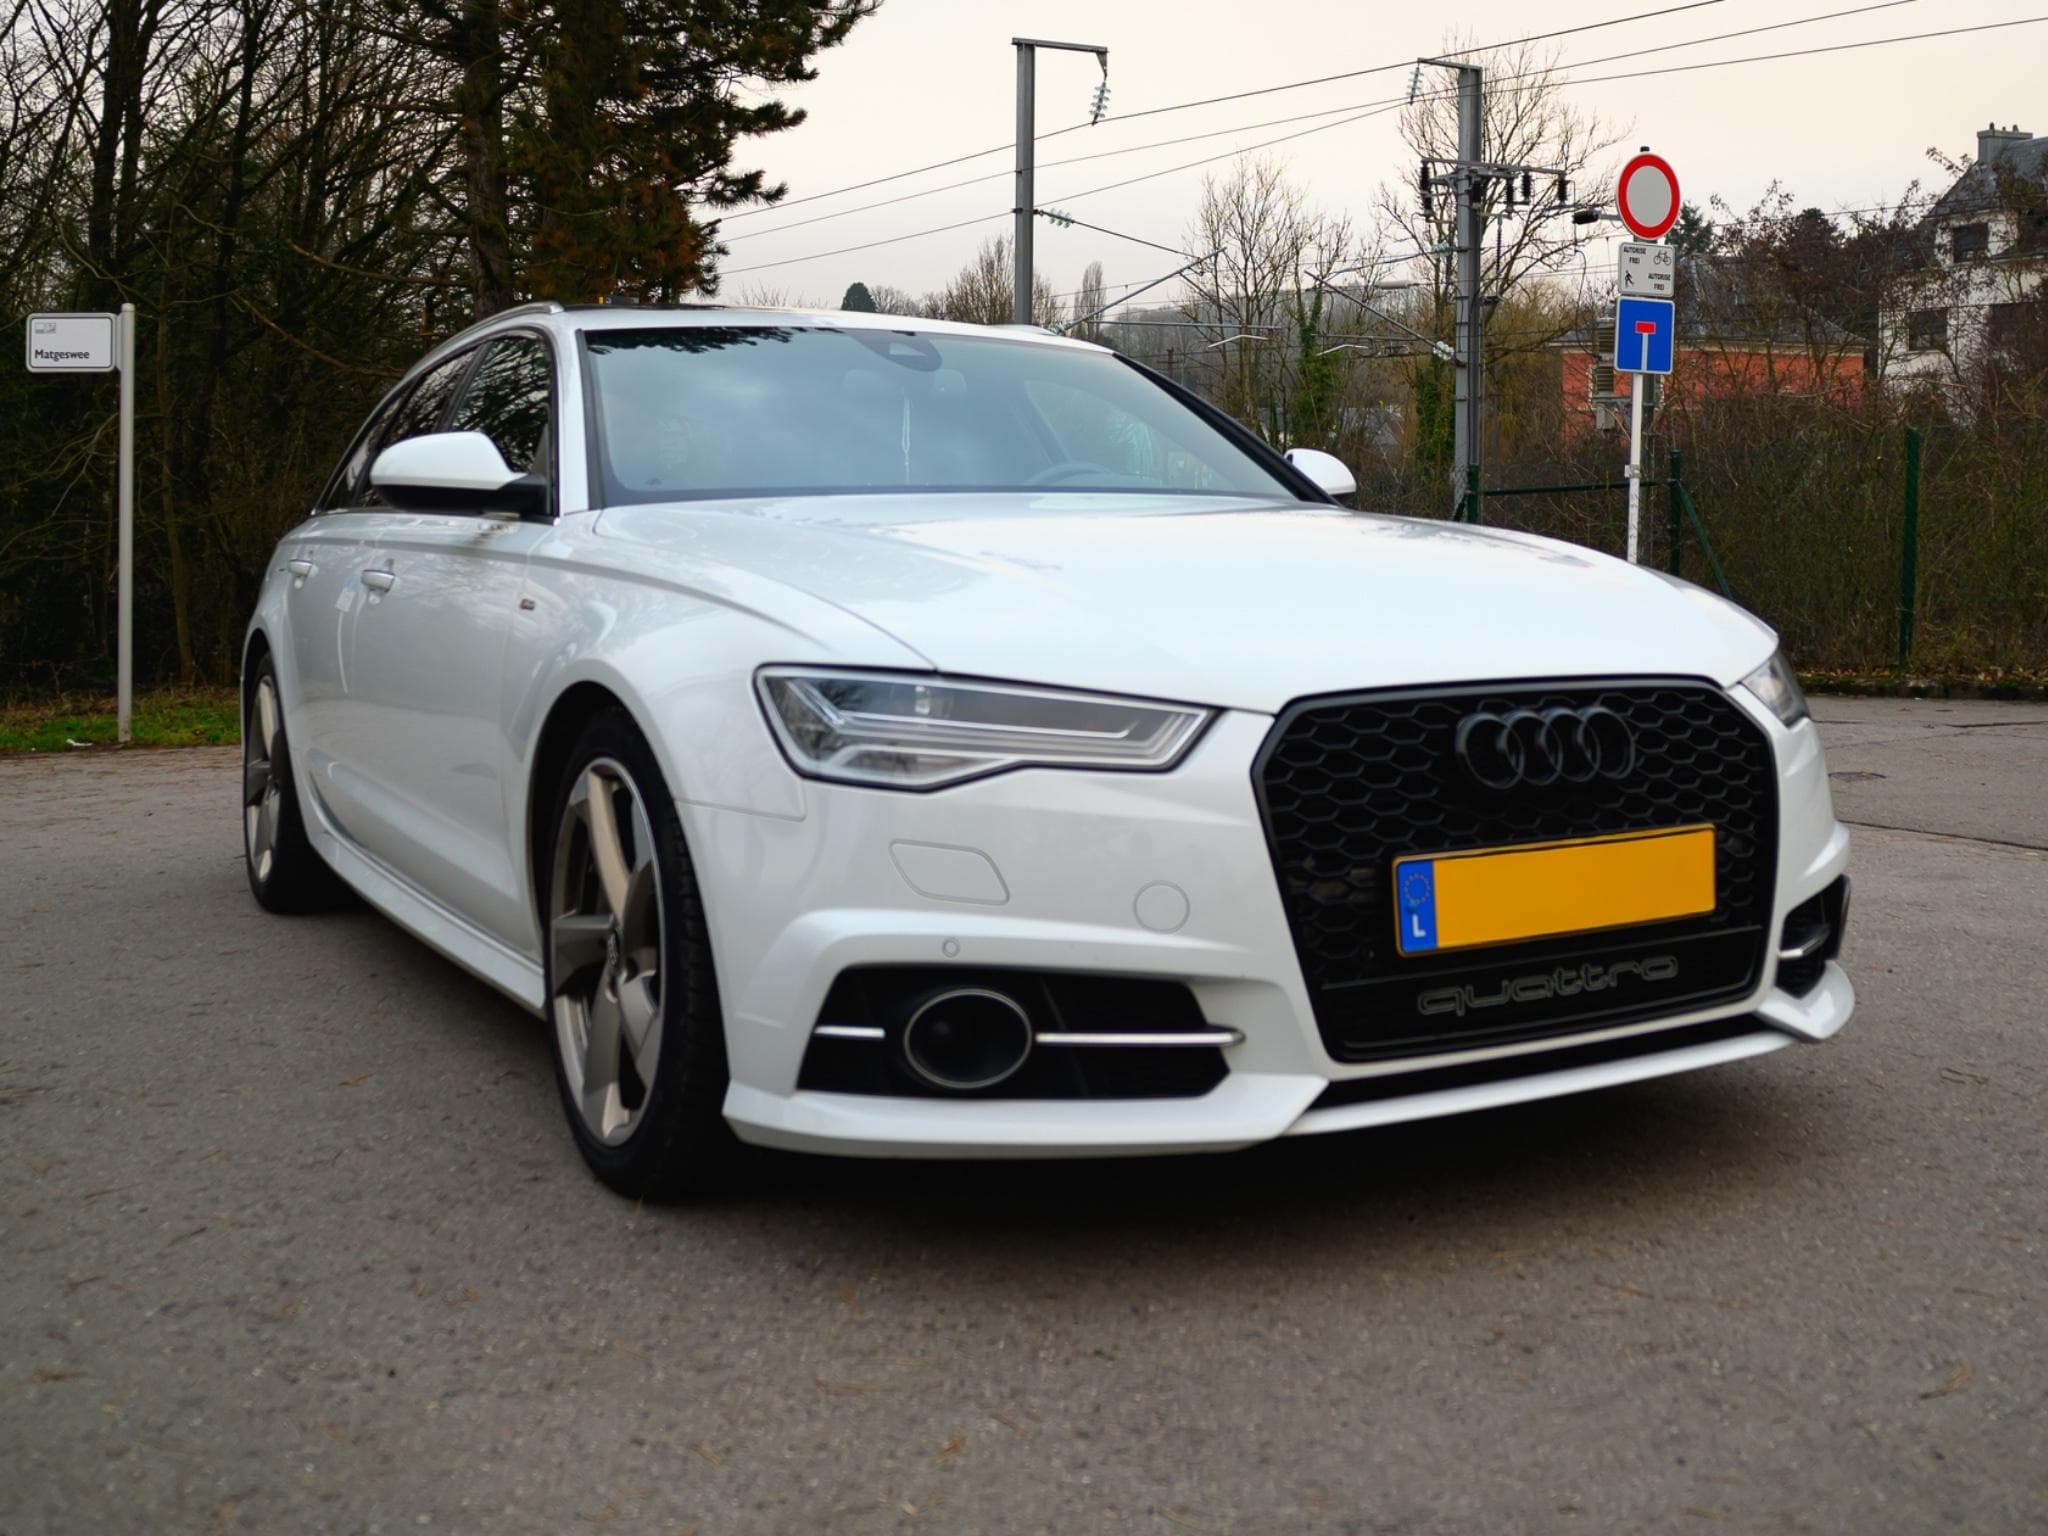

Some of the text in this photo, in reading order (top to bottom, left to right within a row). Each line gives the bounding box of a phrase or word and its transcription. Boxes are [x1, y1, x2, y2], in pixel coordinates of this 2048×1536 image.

[34, 348, 90, 362] Matgeswee
[1412, 914, 1426, 938] L
[1417, 956, 1679, 1017] quattro
